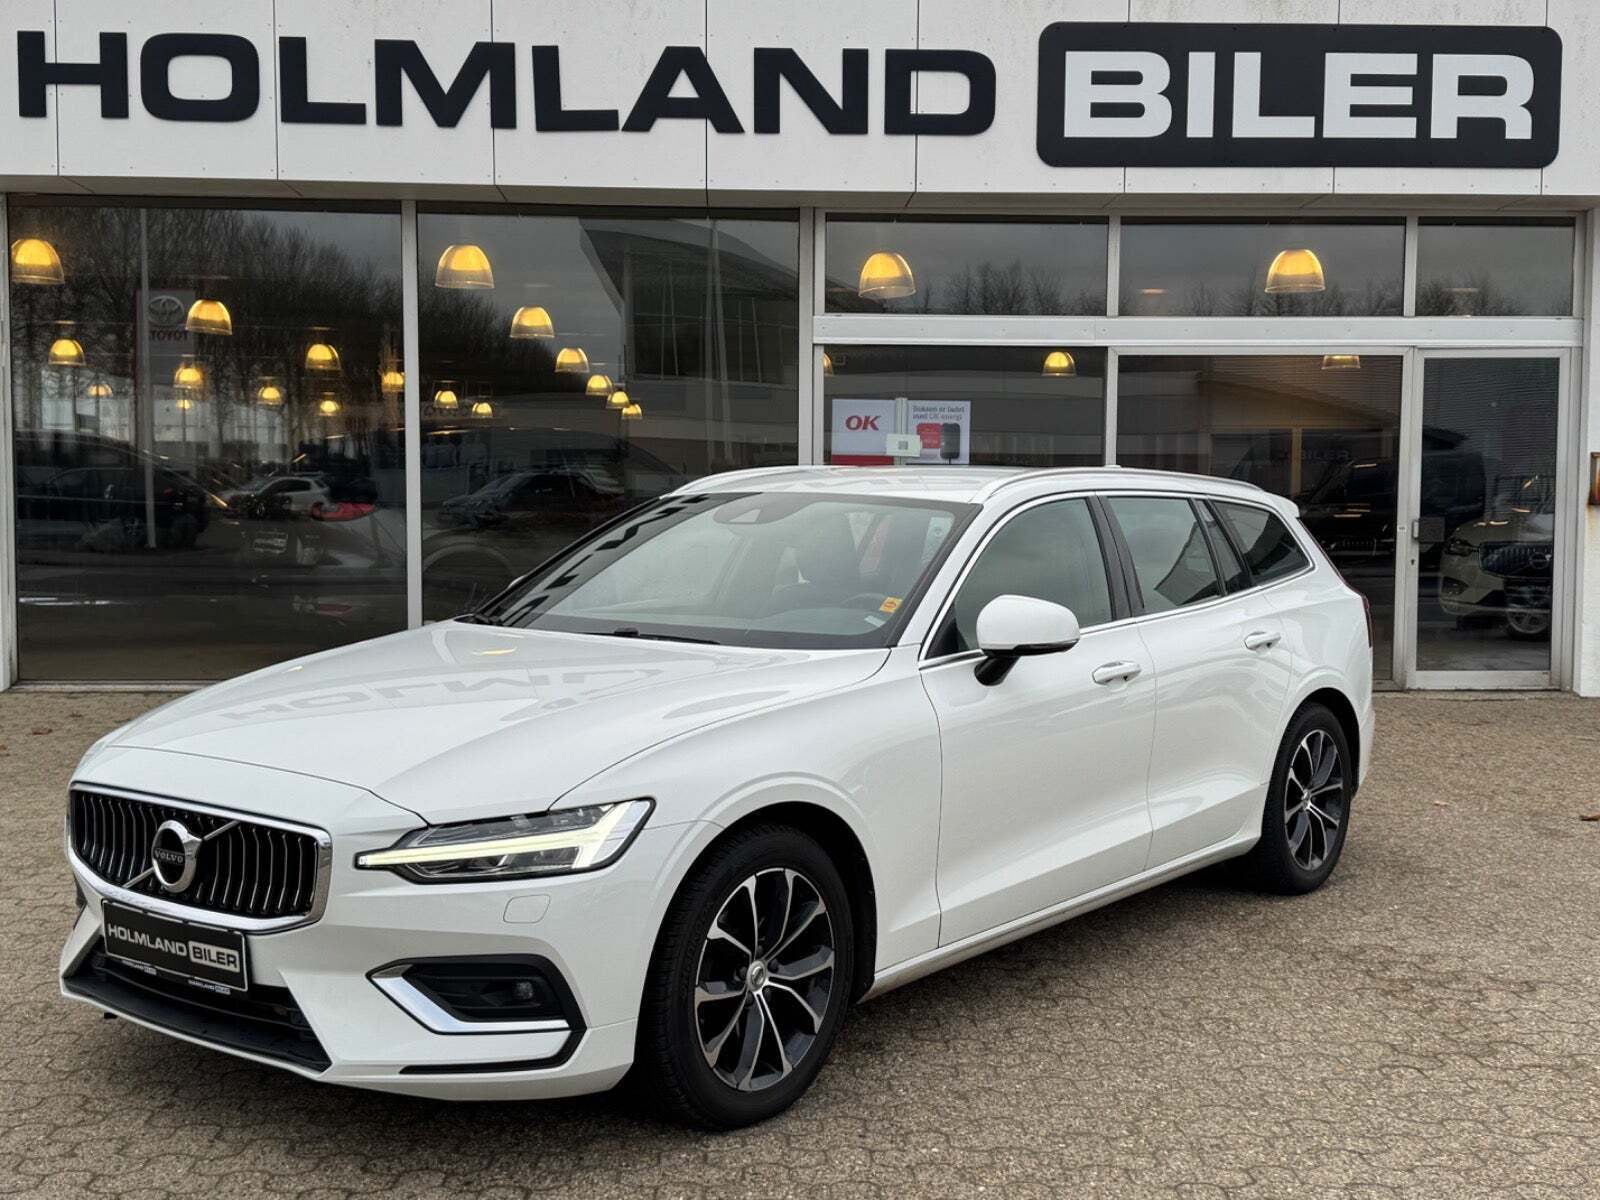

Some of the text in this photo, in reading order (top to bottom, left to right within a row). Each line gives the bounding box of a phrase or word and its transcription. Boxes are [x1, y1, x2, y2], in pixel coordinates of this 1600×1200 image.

[18, 31, 1534, 140] HOLMLAND BILER
[845, 415, 880, 431] OK
[154, 849, 184, 864] VOLVO
[107, 923, 238, 969] HOLMLAND BILER
